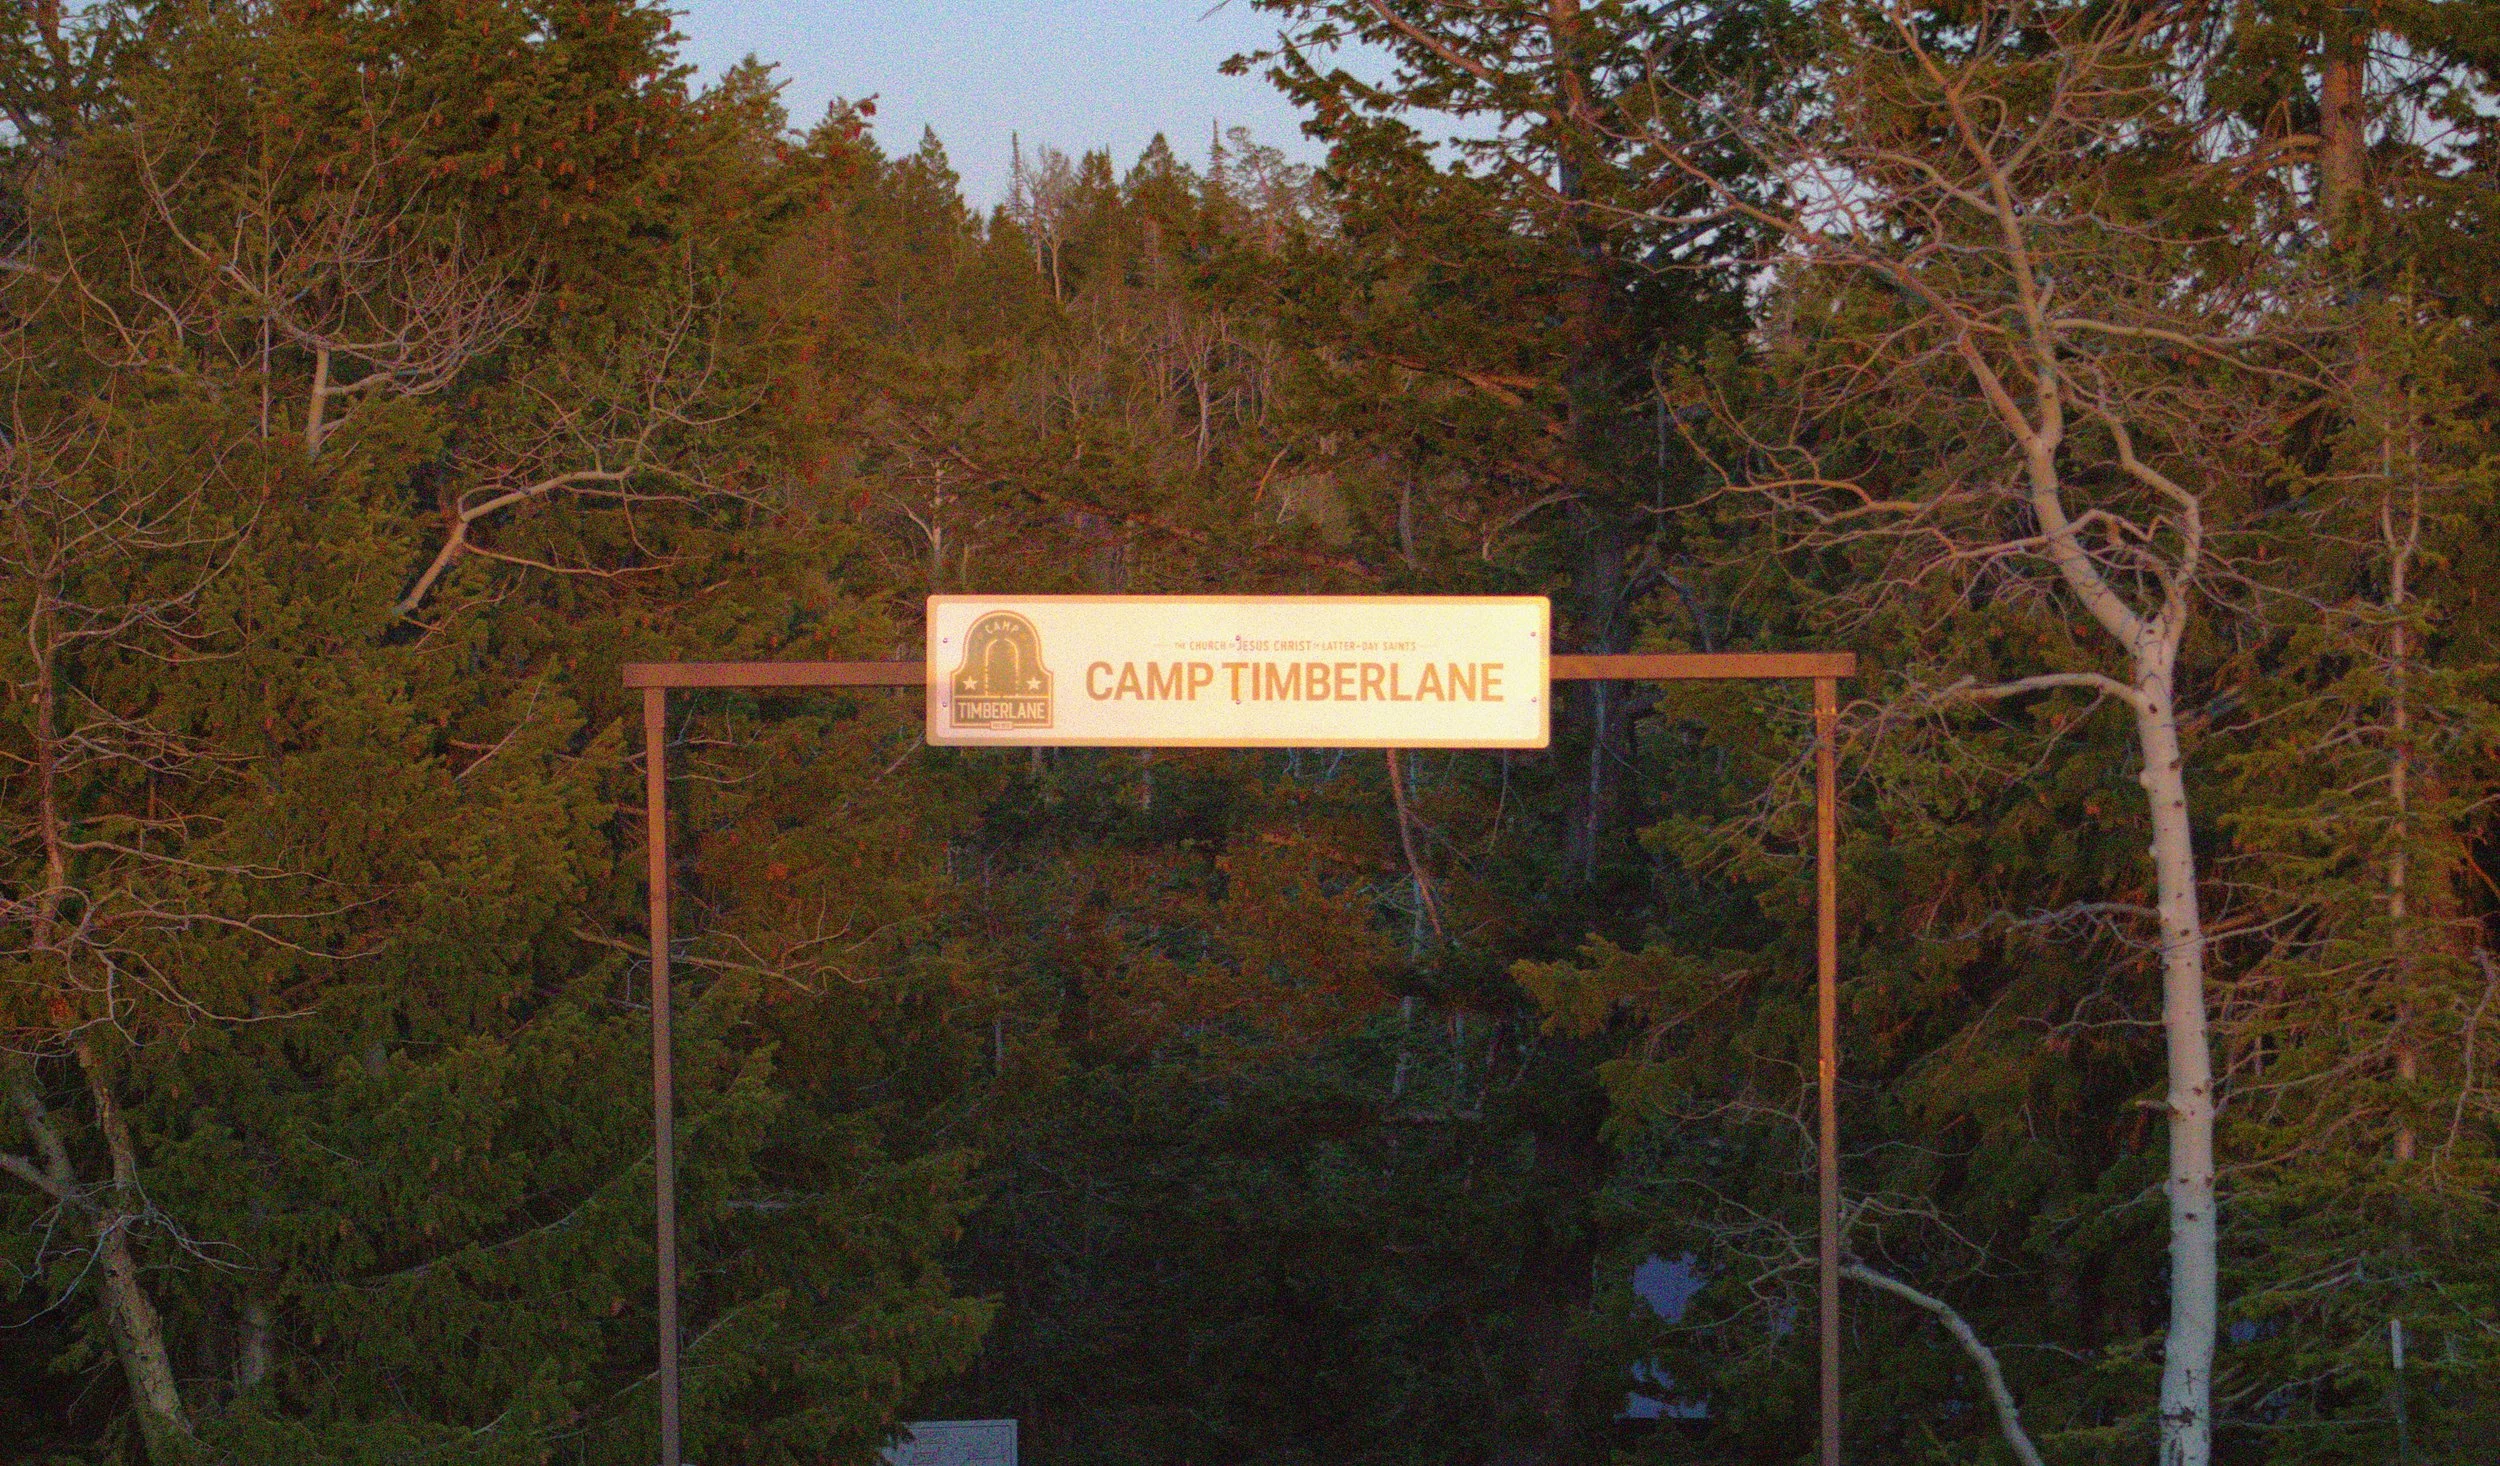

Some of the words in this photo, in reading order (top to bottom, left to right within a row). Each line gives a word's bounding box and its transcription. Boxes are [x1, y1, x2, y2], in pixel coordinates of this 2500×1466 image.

[984, 620, 1020, 634] CAMP
[1189, 640, 1226, 651] CHURCH
[1236, 640, 1269, 651] JESUS
[1273, 640, 1311, 651] CHRIST
[1322, 640, 1378, 651] LATTER-DAY
[1383, 640, 1416, 651] SAINTS
[1086, 661, 1214, 701] CAMP
[1222, 661, 1505, 701] TIMBERLANE
[957, 702, 1045, 719] TIMBERLANE
